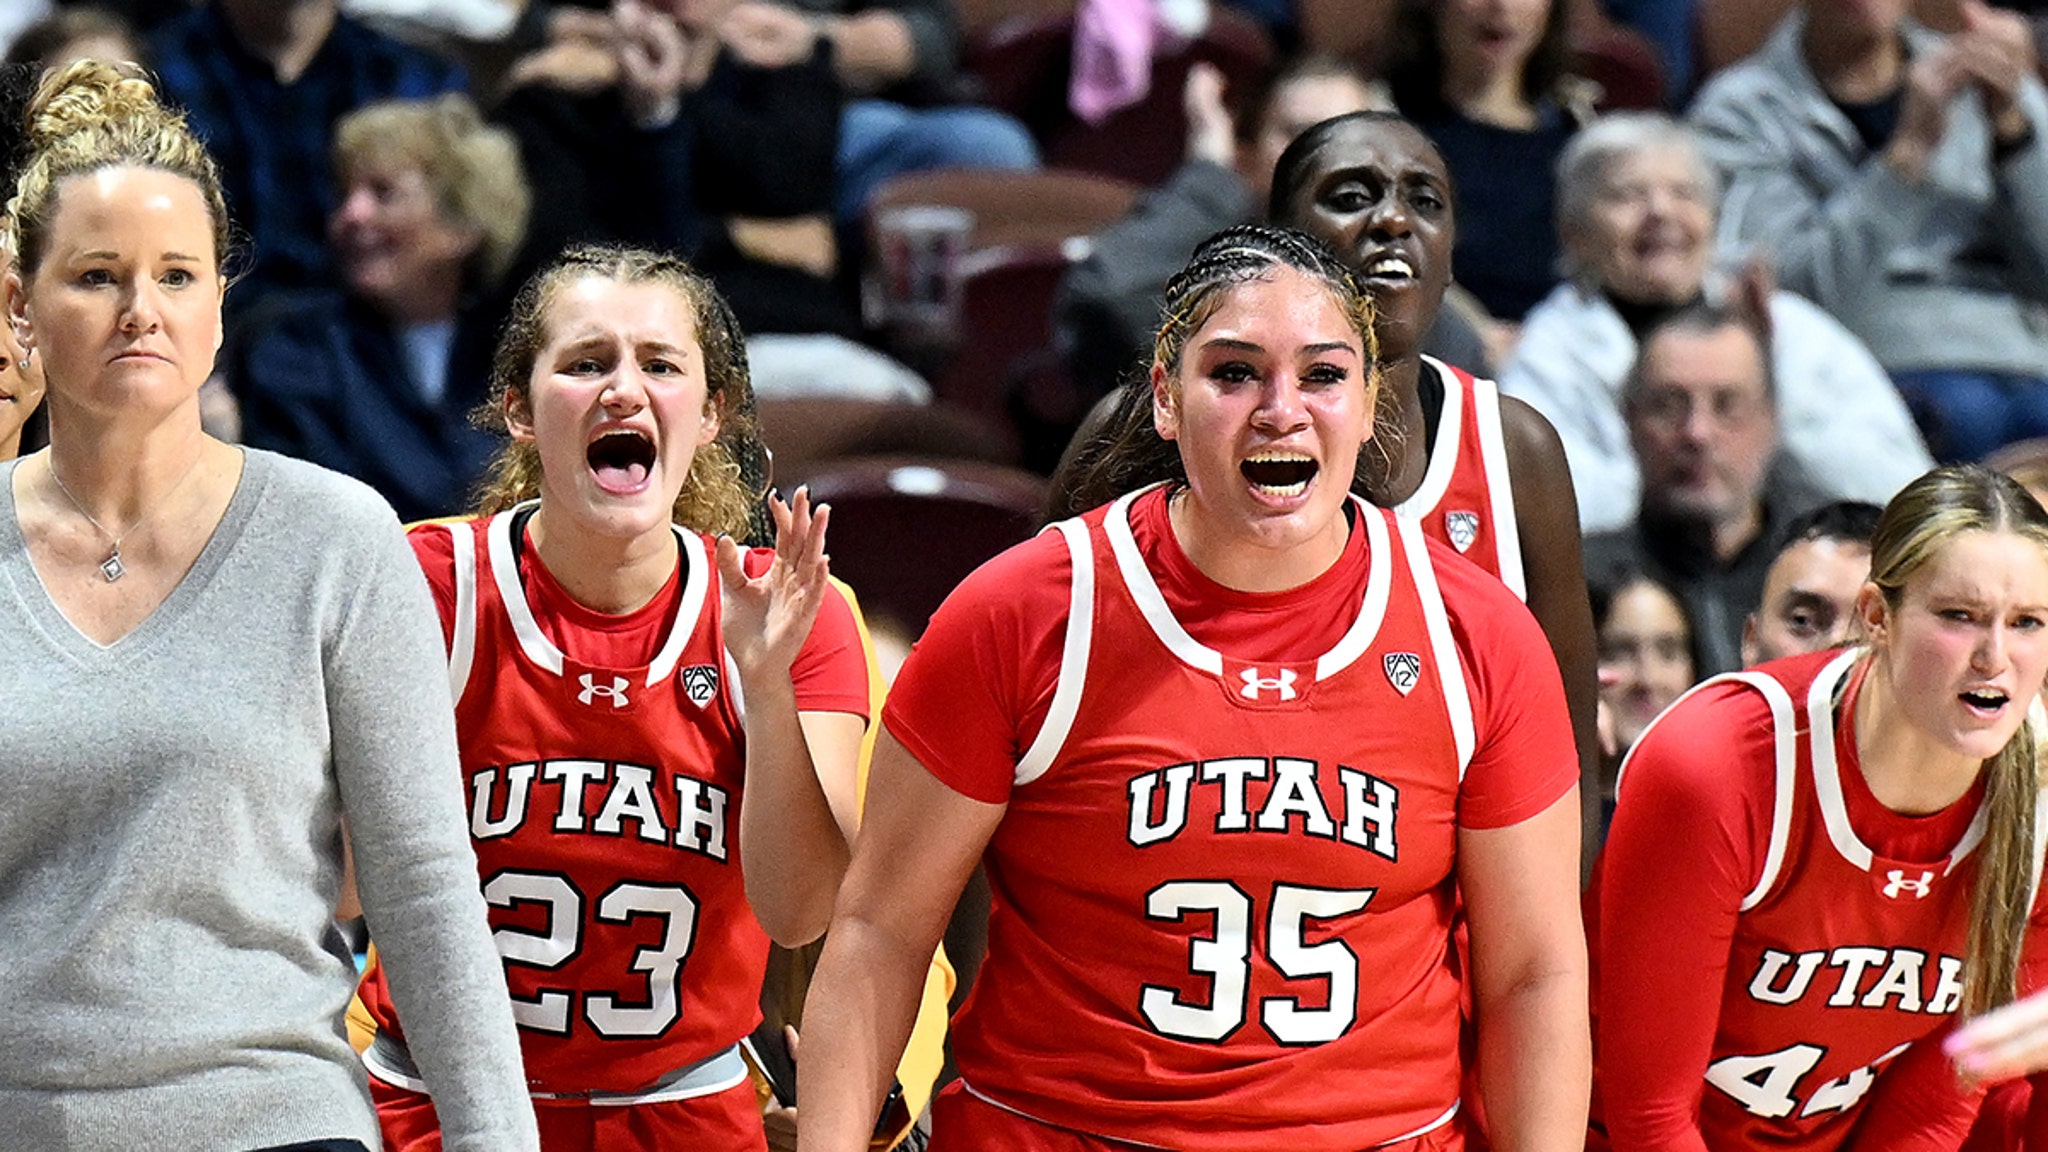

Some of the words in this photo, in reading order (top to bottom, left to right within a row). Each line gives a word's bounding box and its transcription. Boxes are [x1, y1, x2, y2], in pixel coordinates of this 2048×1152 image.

[682, 665, 718, 692] PAC
[692, 684, 709, 700] 12
[1385, 653, 1419, 678] PAC
[1395, 670, 1412, 687] 12
[470, 758, 727, 864] UTAH
[1126, 756, 1399, 863] UTAH
[481, 867, 700, 1039] 23
[1139, 879, 1379, 1047] 35
